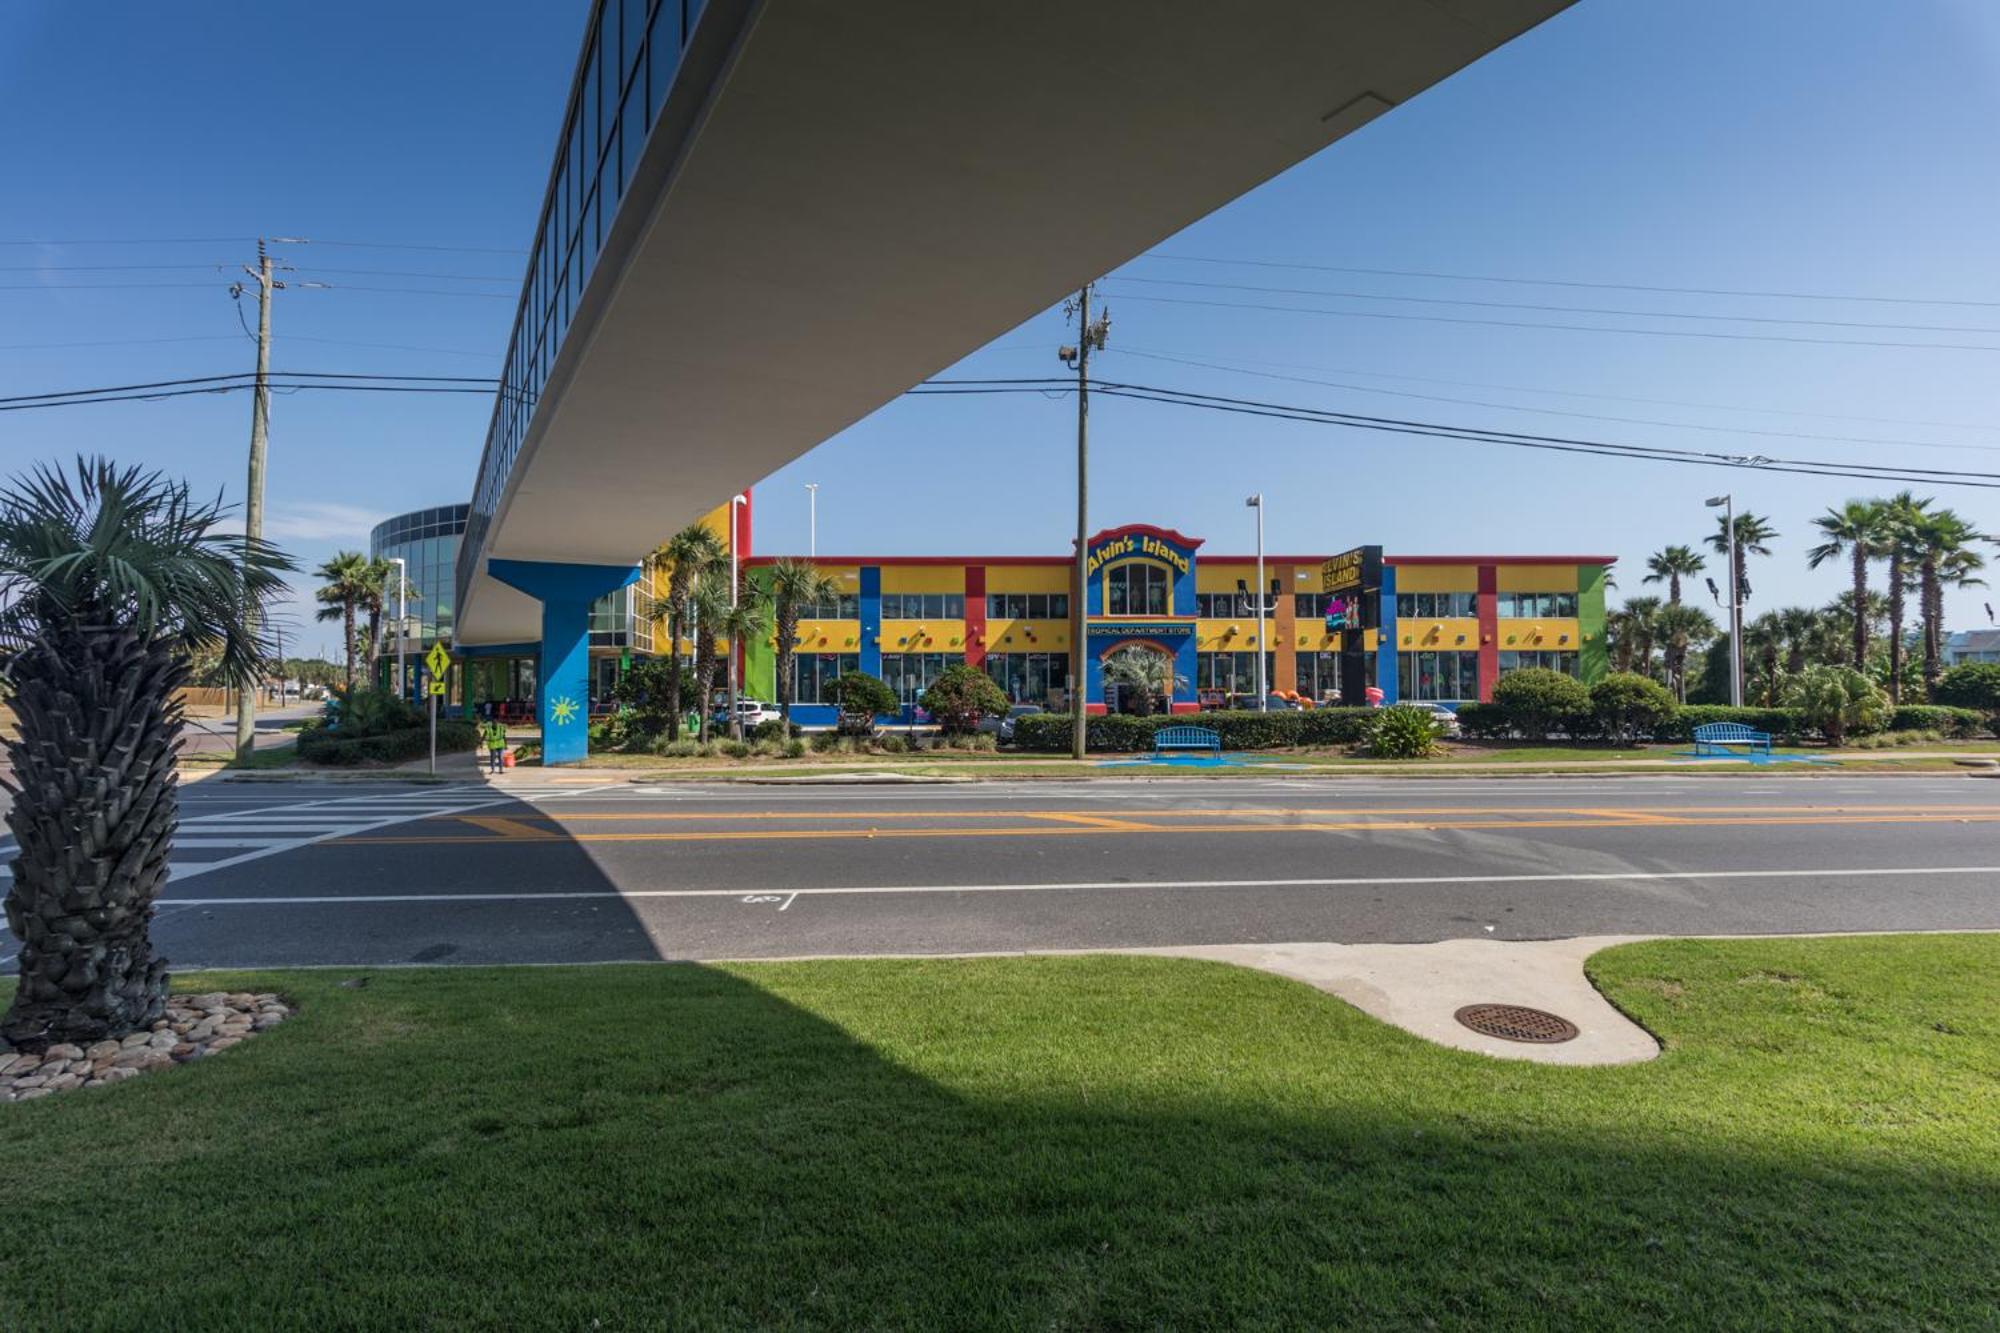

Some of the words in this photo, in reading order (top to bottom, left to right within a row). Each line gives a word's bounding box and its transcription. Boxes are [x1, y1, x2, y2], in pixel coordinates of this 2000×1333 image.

[1088, 535, 1134, 576] Alvin's
[1143, 535, 1189, 575] Island
[1322, 566, 1357, 587] ISLAND
